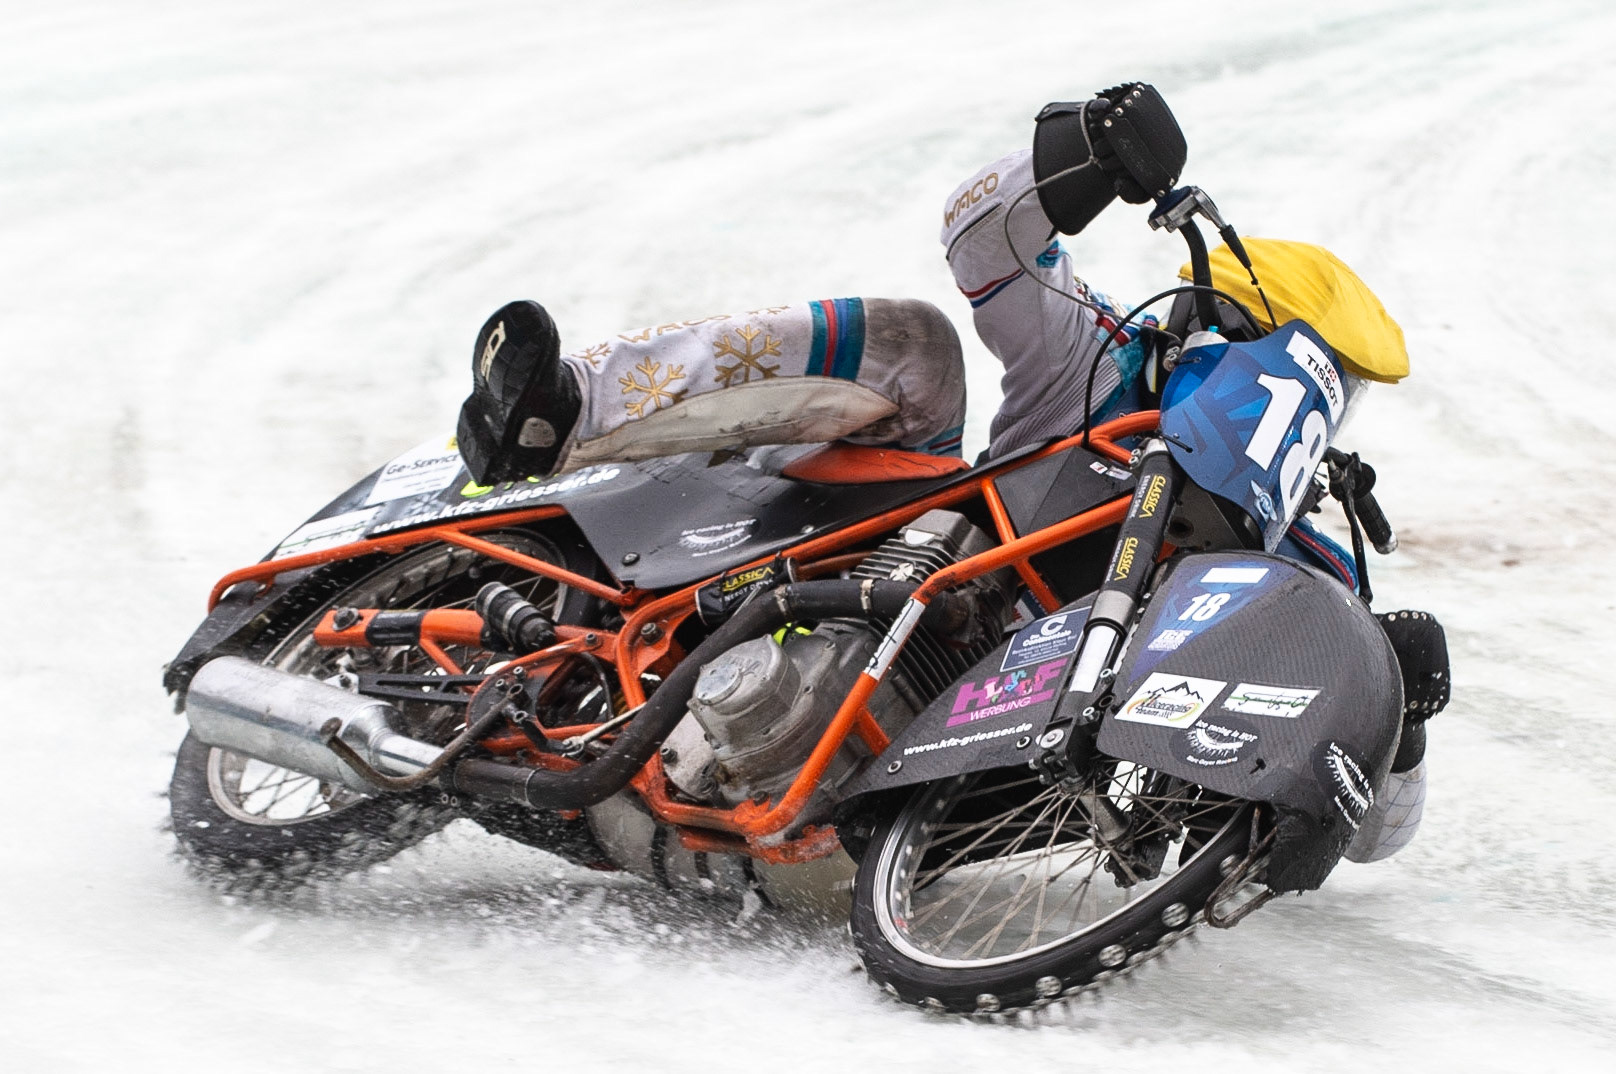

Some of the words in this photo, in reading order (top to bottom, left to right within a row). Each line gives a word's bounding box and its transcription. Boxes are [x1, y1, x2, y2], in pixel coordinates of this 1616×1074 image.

[944, 172, 999, 229] WACO
[1307, 353, 1339, 407] TISSOT
[1245, 373, 1328, 523] 18
[1138, 473, 1167, 518] CLASSICA
[721, 566, 775, 592] LASSICA
[1114, 536, 1139, 581] CLASSICA
[1178, 593, 1232, 622] 18
[970, 697, 1032, 721] WERBUNG
[903, 722, 1034, 756] www.kfz-griesser.de
